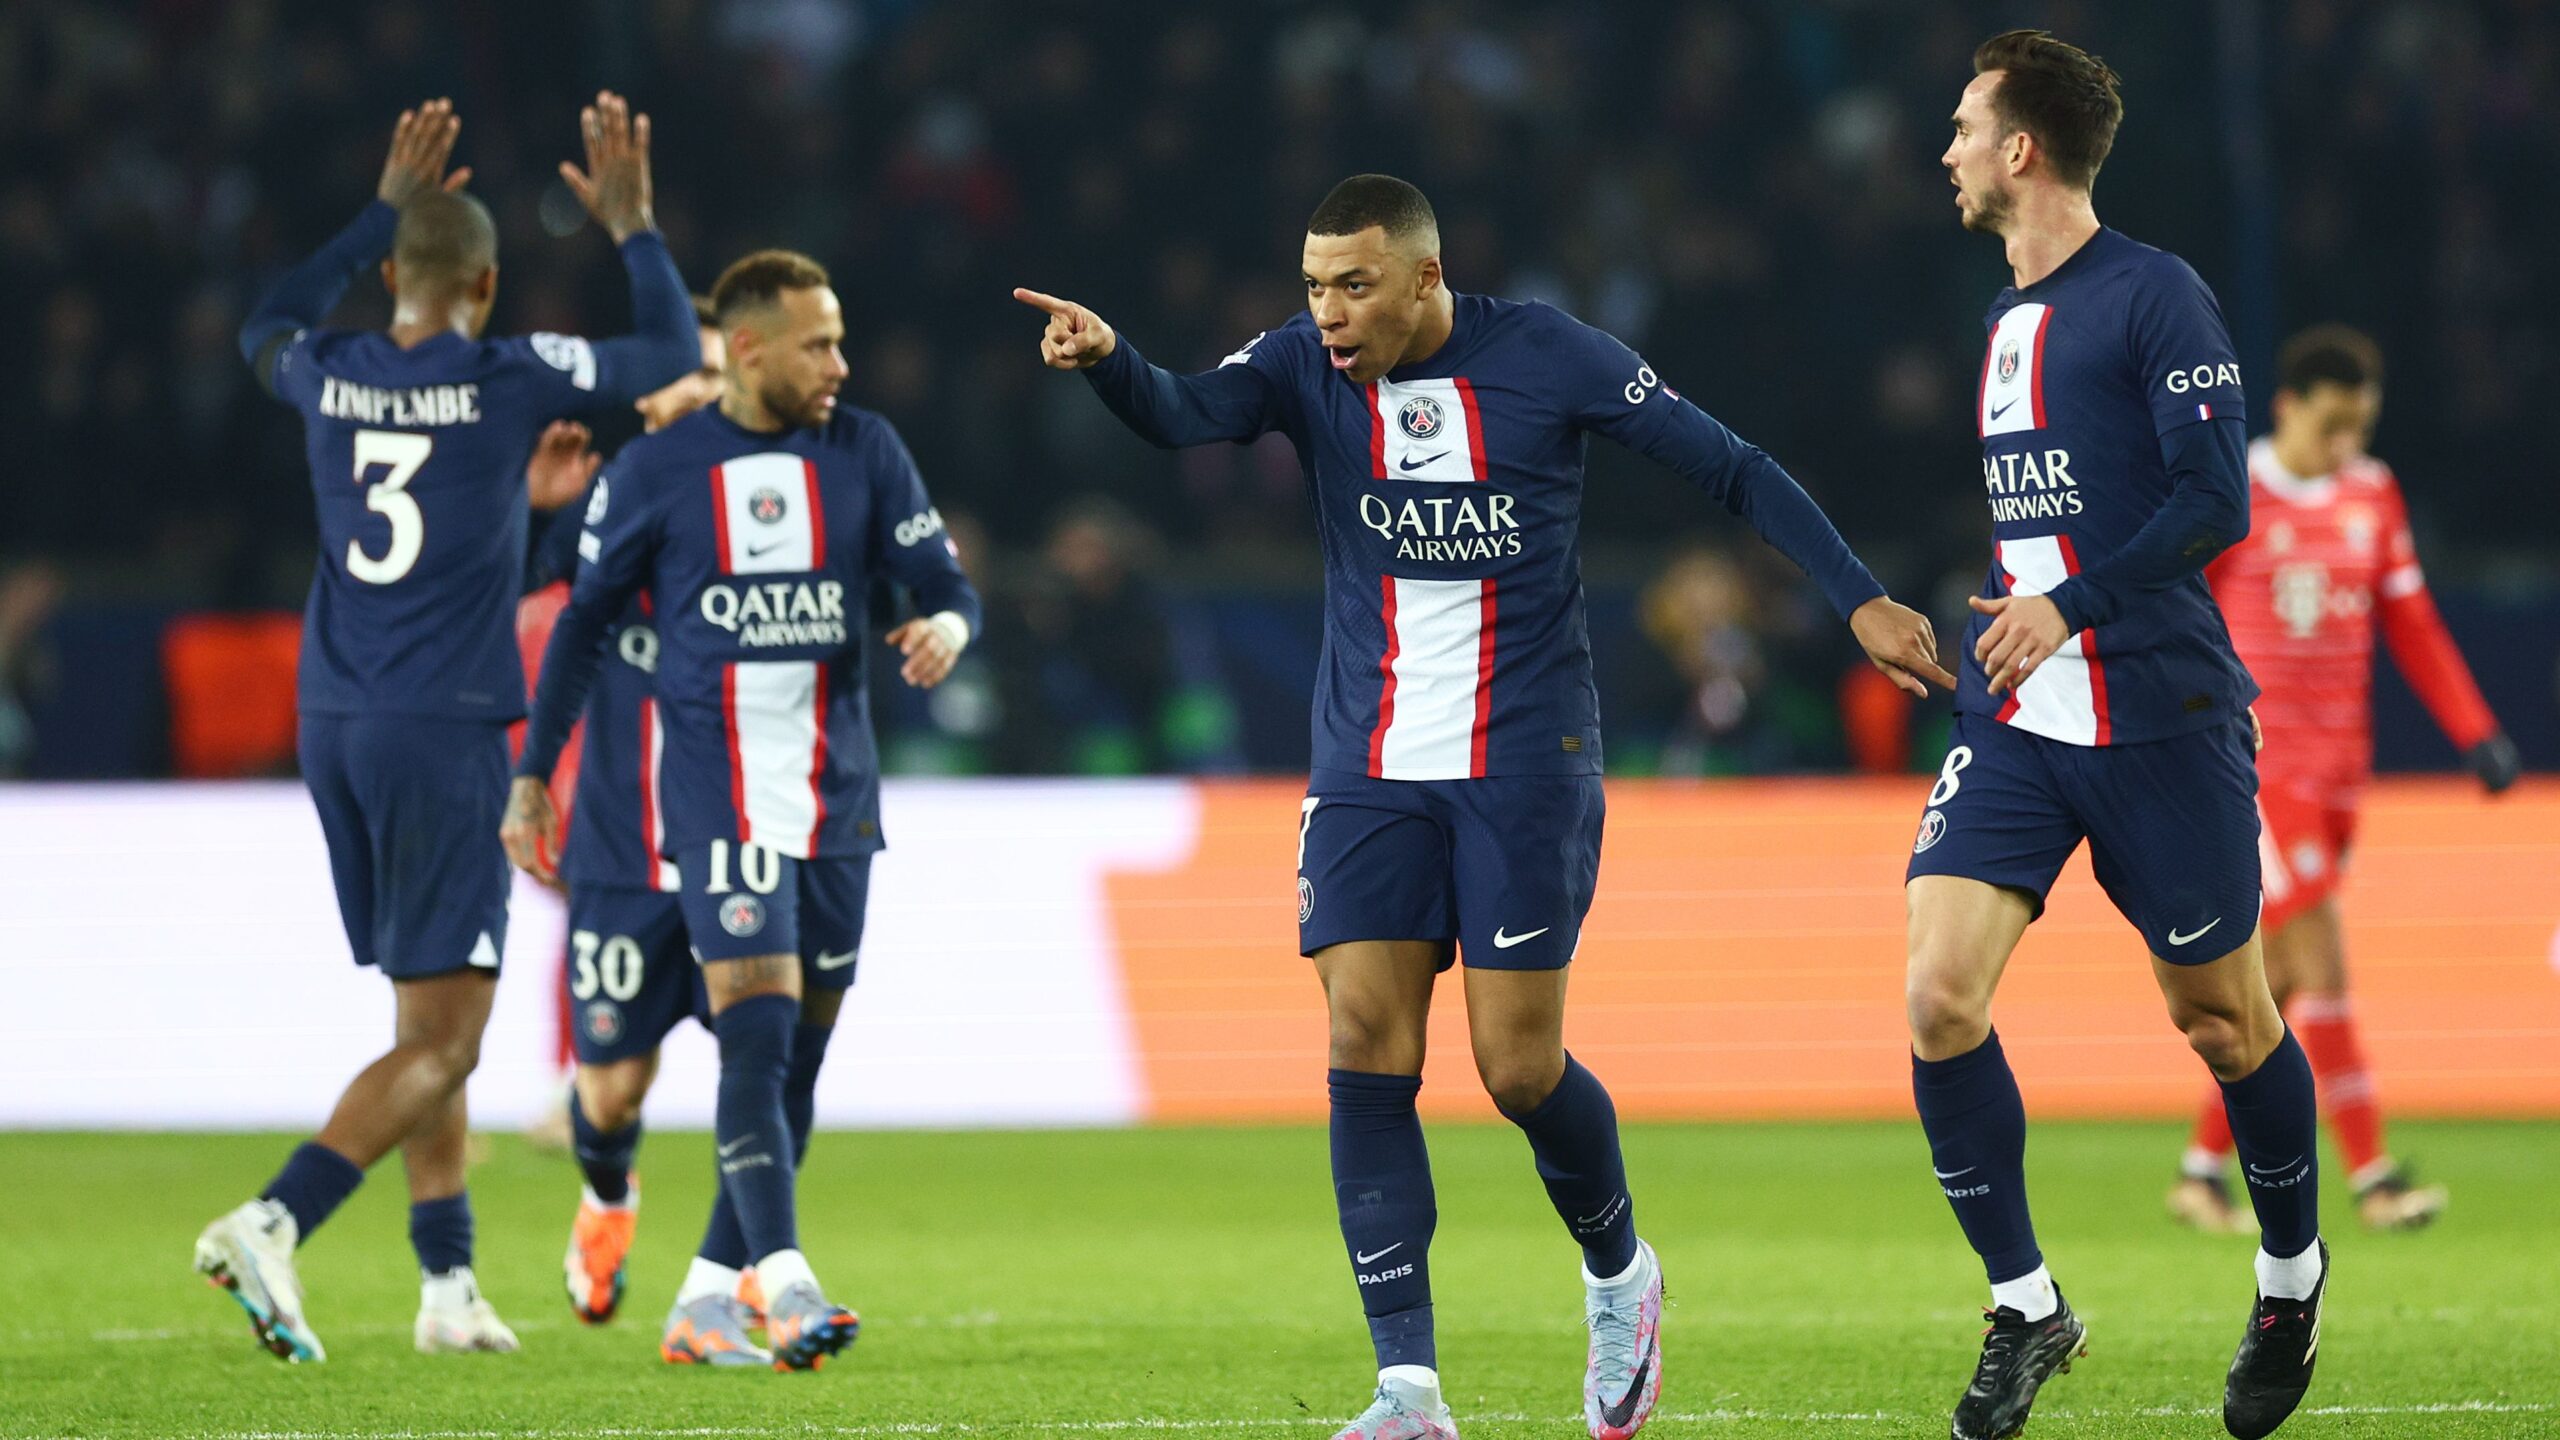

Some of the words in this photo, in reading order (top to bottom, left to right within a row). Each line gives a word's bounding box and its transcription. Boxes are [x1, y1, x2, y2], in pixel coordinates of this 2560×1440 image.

[2166, 363, 2242, 394] GOAT
[1982, 449, 2078, 495] ATAR
[346, 429, 433, 584] 3
[1359, 493, 1520, 541] QATAR
[1987, 490, 2084, 522] AIRWAYS
[1396, 532, 1522, 562] AIRWAYS
[700, 580, 845, 631] QATAR
[738, 620, 847, 648] AIRWAYS
[1927, 745, 1973, 806] 8
[1298, 797, 1320, 870] 7
[705, 838, 781, 895] 10
[571, 929, 644, 1001] 30
[2249, 1164, 2309, 1189] PARIS
[1358, 1263, 1413, 1285] PARIS
